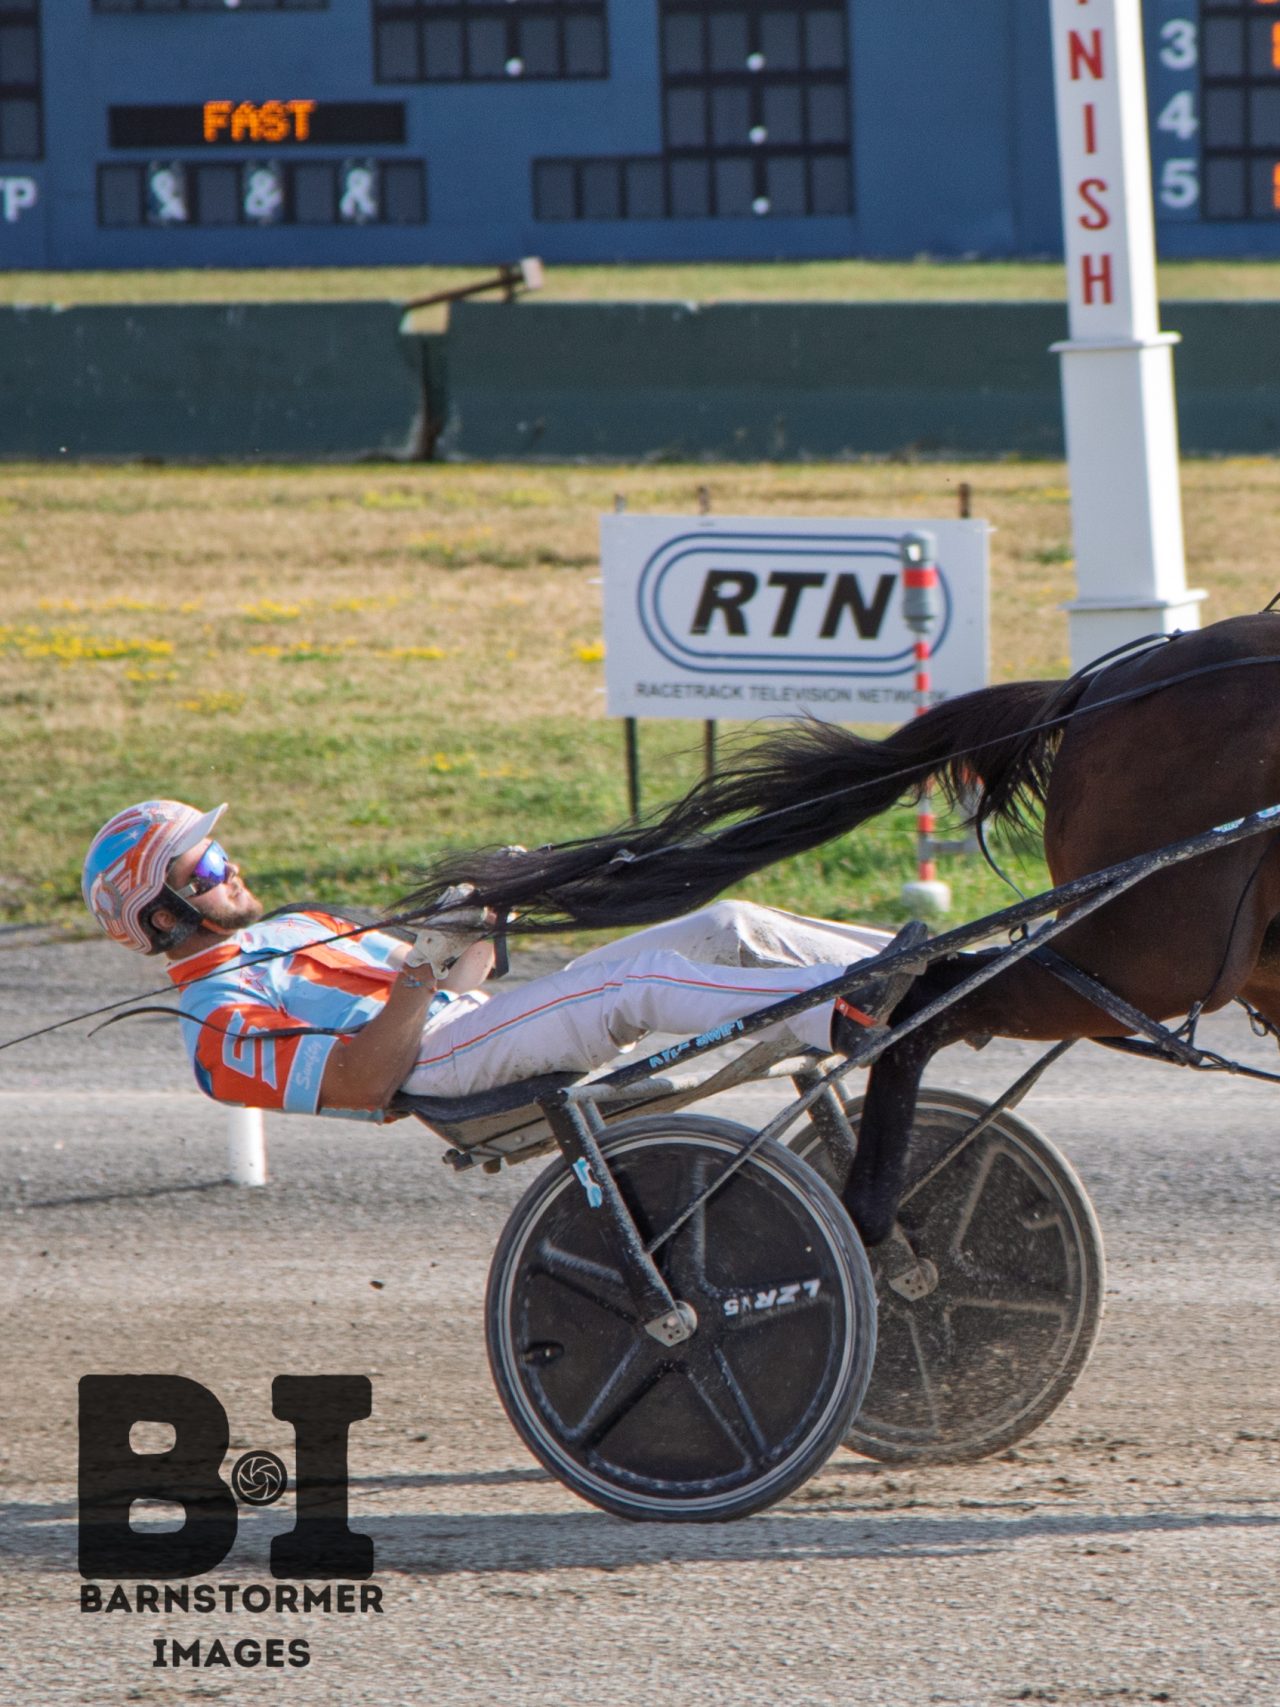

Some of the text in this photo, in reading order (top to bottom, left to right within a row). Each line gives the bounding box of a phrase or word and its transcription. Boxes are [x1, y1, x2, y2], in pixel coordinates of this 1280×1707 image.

[1159, 18, 1198, 69] 3
[202, 100, 317, 143] FAST
[1158, 90, 1198, 139] 4
[1067, 0, 1113, 305] NISH
[1160, 159, 1198, 208] 5
[689, 570, 898, 640] RTN
[635, 682, 743, 701] RACETRACK
[749, 686, 851, 703] TELEVISION
